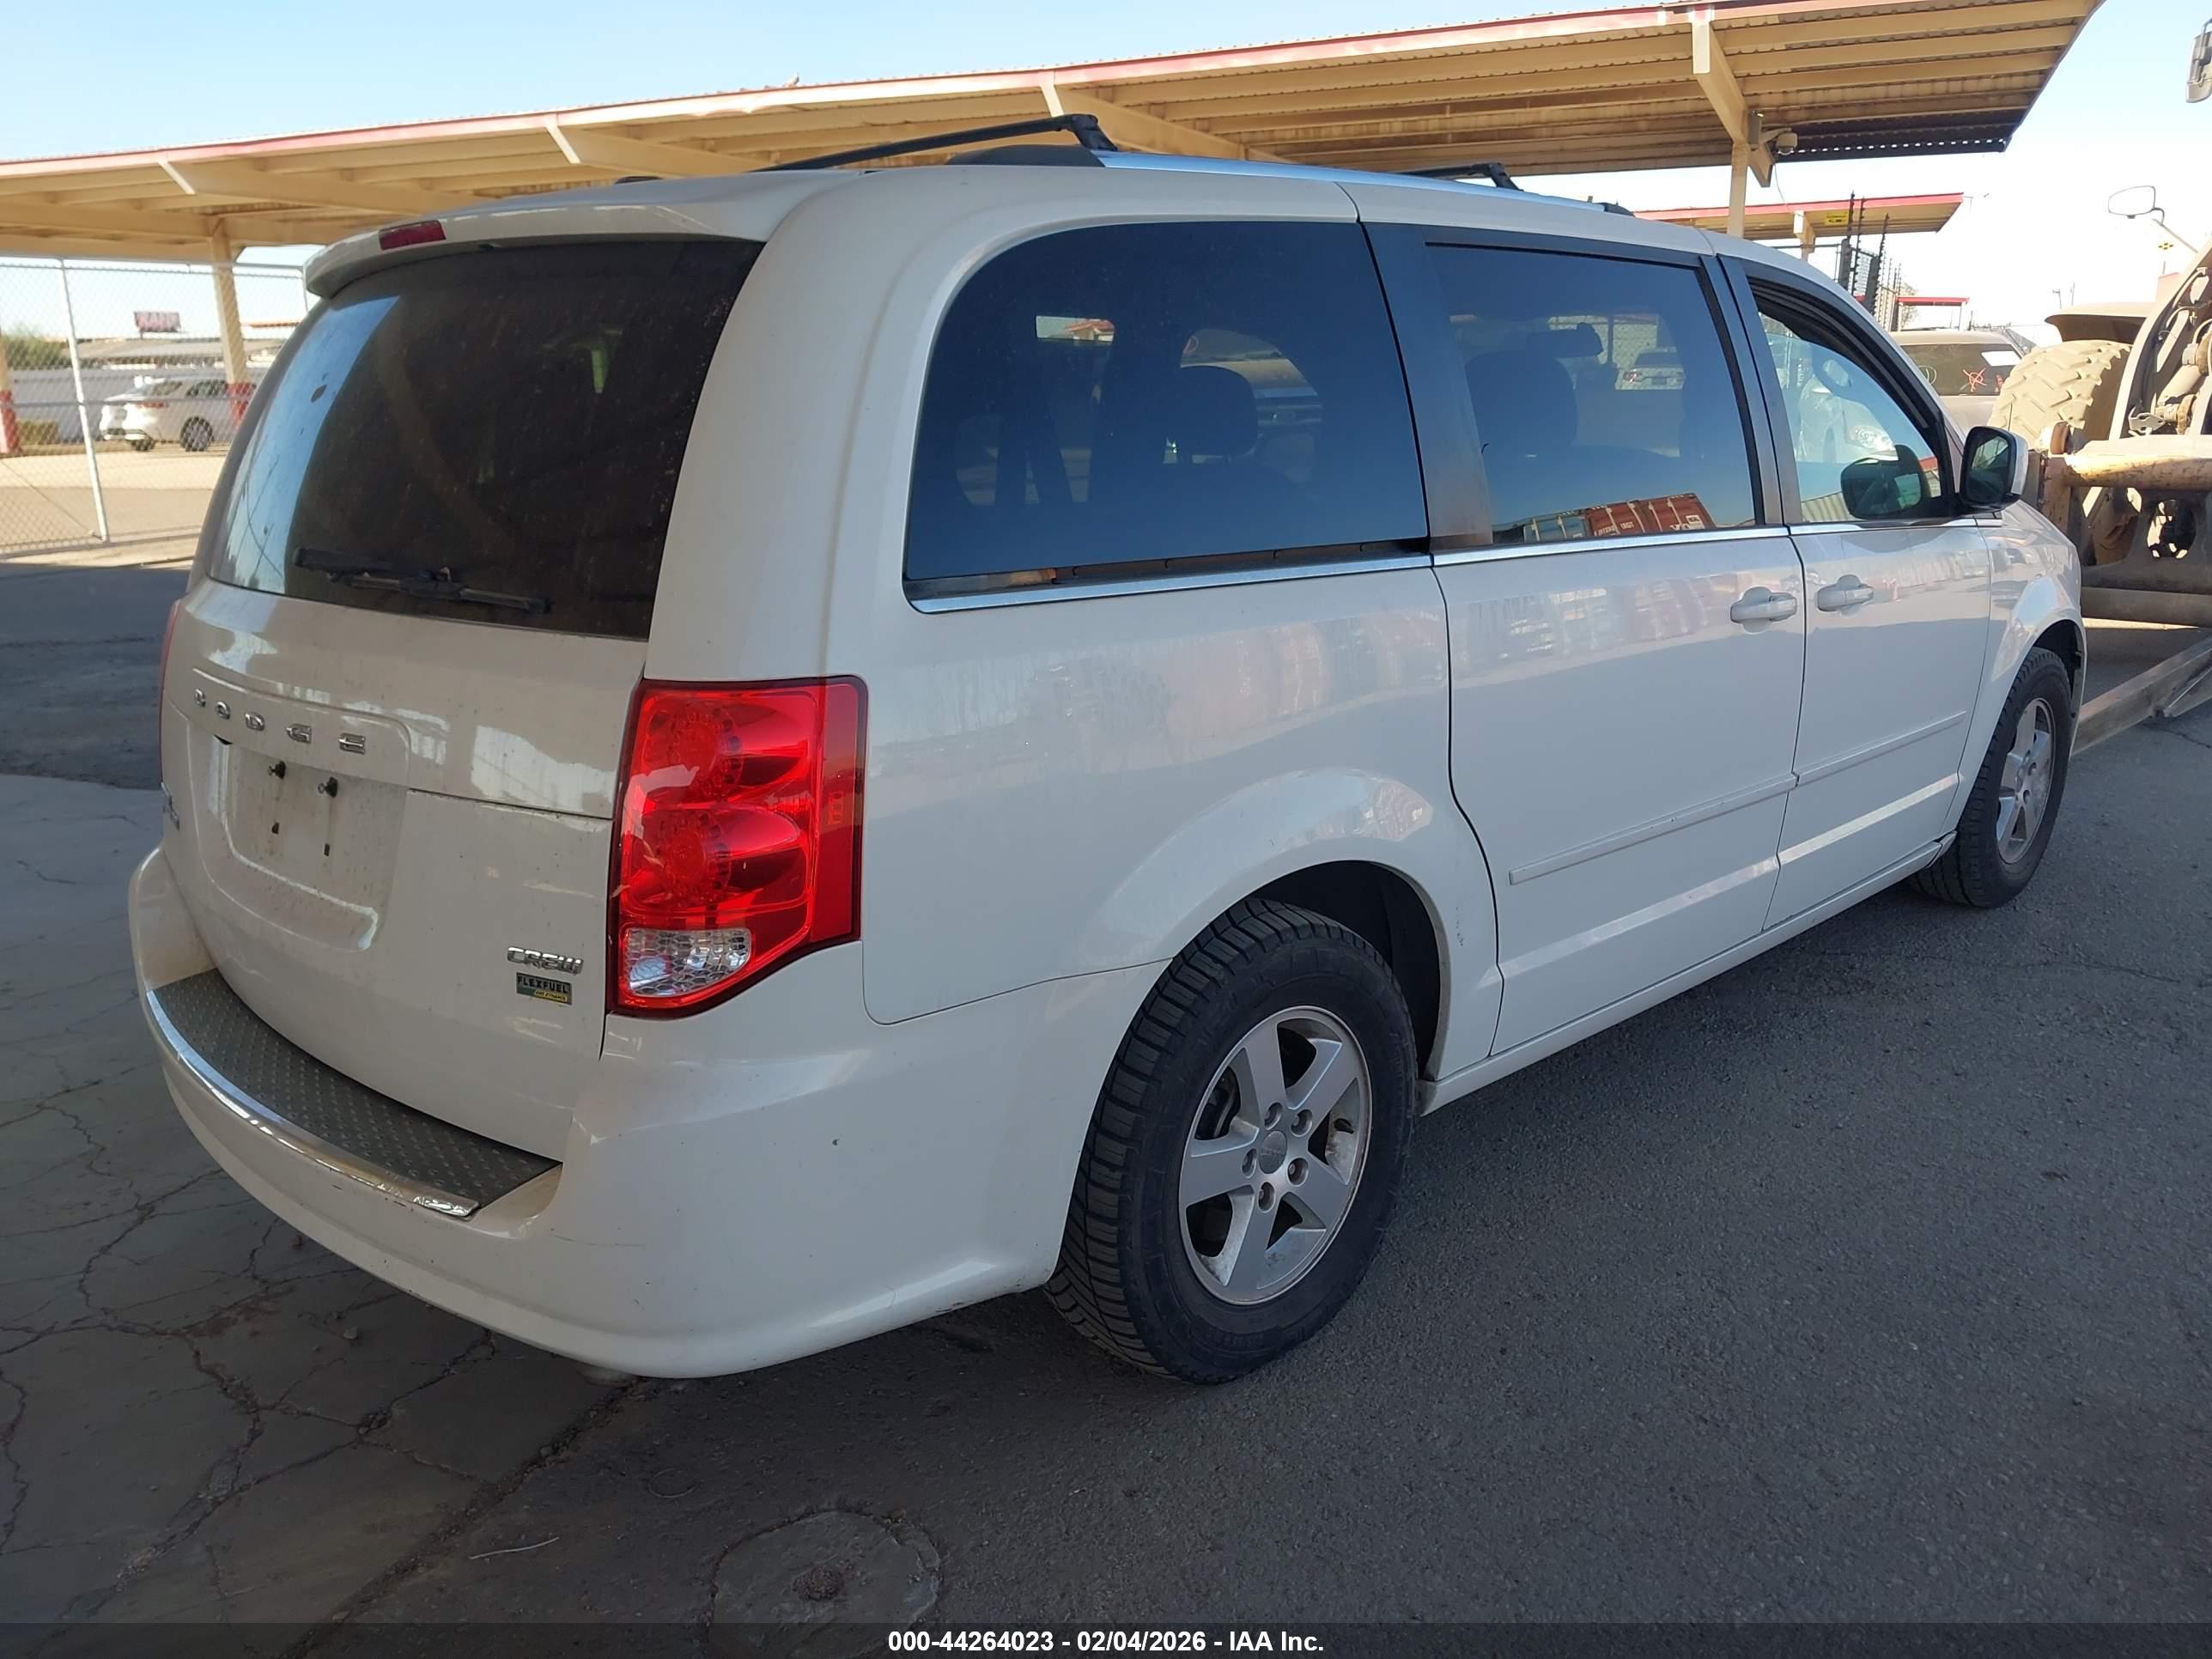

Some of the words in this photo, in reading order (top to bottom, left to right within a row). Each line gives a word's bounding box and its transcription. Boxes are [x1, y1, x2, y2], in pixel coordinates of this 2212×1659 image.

[194, 688, 366, 755] DODGE
[507, 946, 584, 975] CREW
[517, 975, 568, 994] FLEXFUEL
